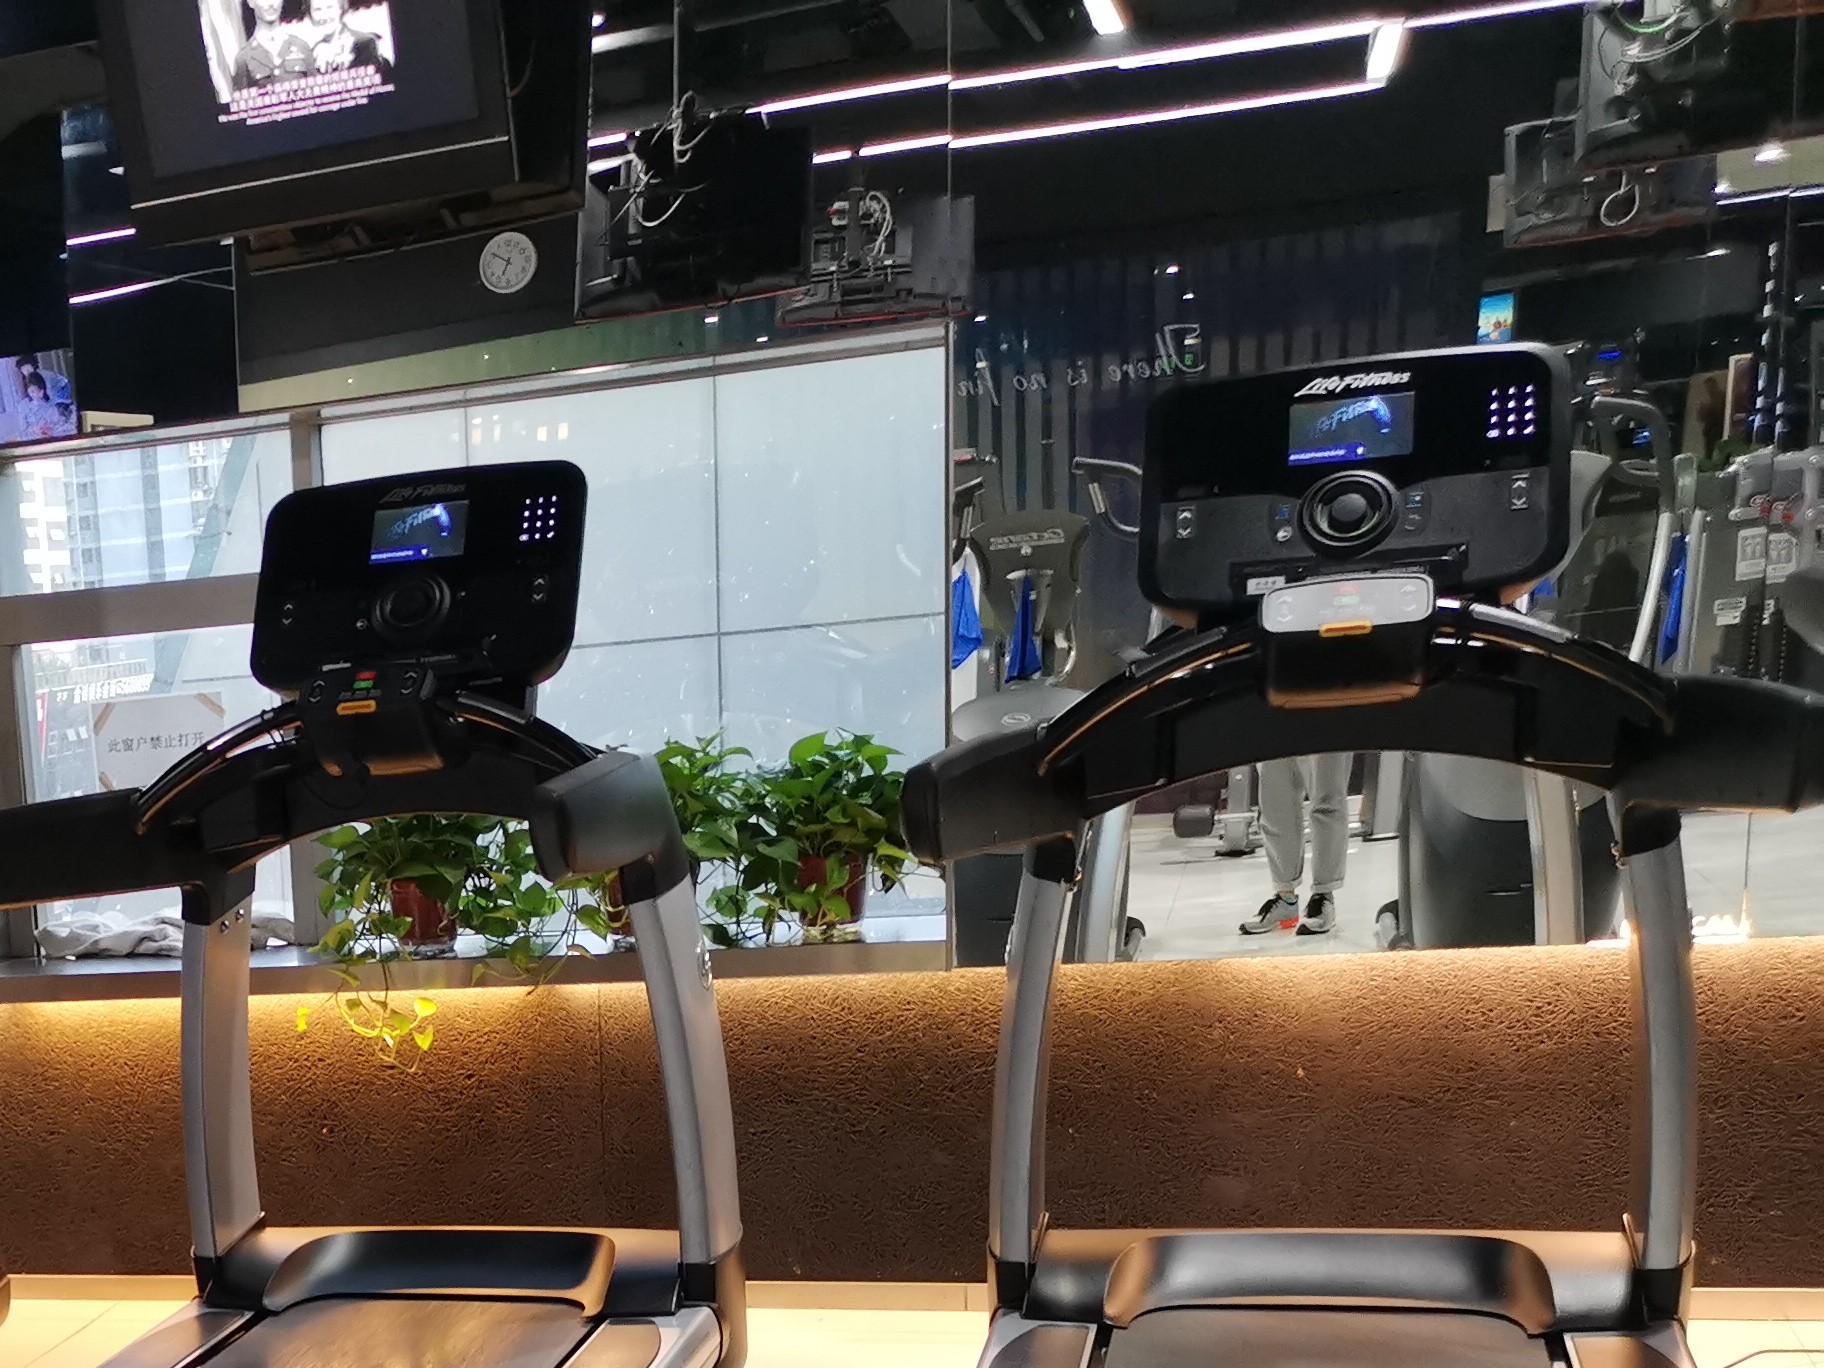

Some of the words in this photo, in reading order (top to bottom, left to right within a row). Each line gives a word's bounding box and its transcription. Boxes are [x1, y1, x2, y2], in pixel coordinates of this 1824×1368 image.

[108, 731, 205, 753] 此窗户禁止打开
